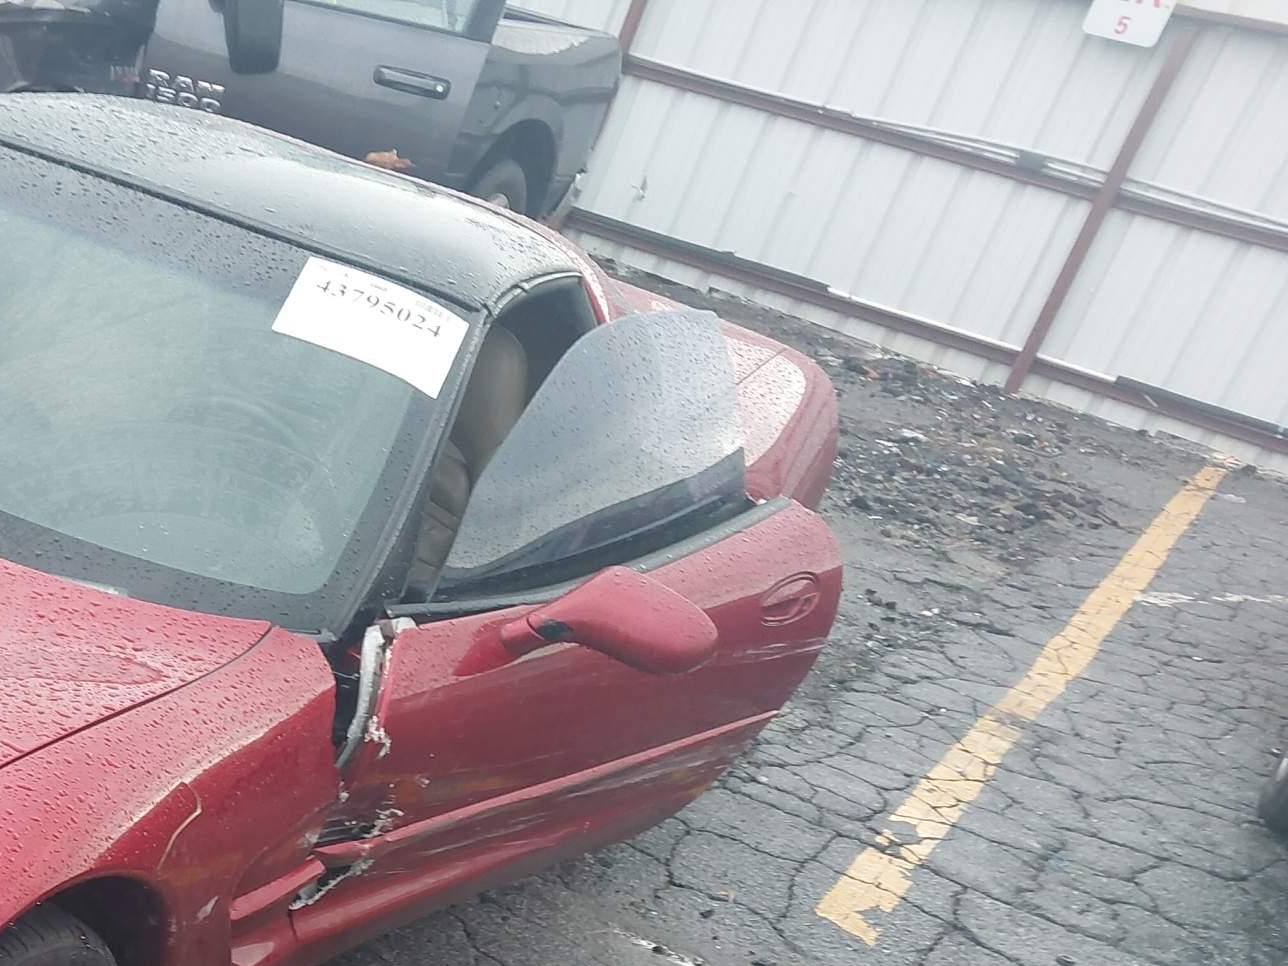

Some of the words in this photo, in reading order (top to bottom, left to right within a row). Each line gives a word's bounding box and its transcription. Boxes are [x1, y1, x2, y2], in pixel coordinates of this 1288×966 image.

[1113, 15, 1132, 35] 5
[147, 67, 226, 95] RAM
[144, 82, 223, 114] 1500
[315, 278, 442, 339] 43795024
